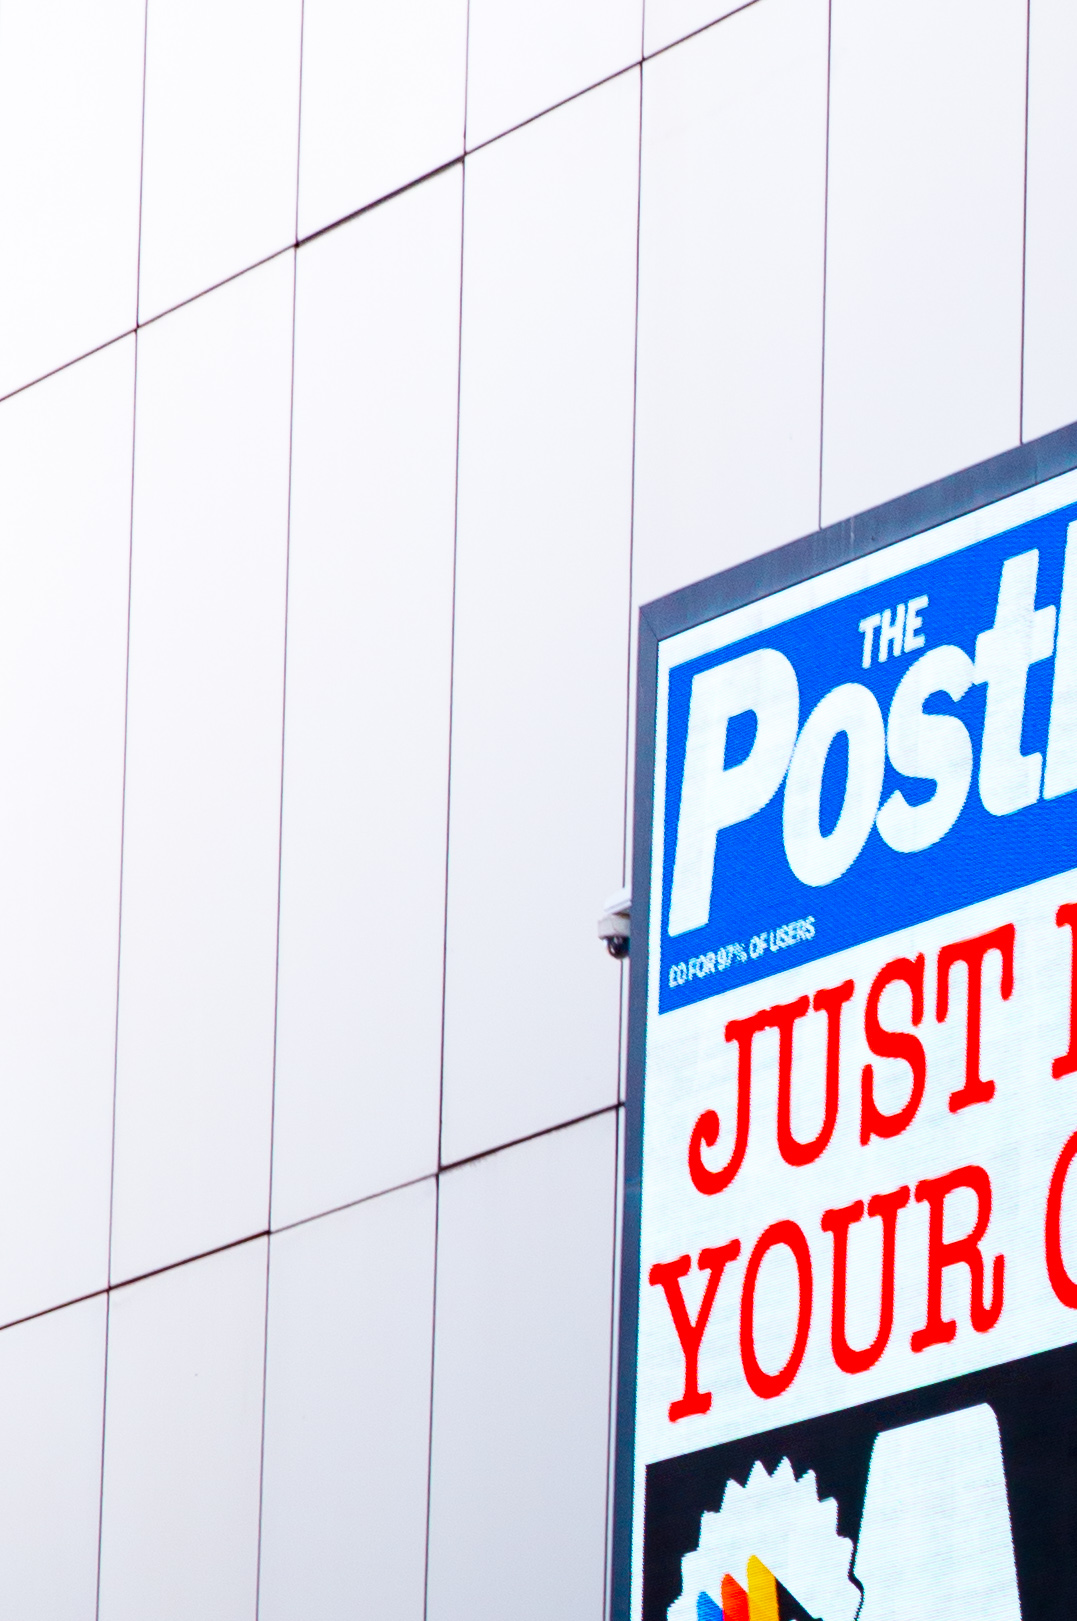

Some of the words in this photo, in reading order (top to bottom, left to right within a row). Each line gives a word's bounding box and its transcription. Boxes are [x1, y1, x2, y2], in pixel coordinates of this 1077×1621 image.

[858, 595, 930, 669] THE
[688, 951, 717, 981] FOR
[749, 931, 769, 960] OF
[769, 915, 816, 953] USERS
[687, 922, 1015, 1197] JUST
[648, 1164, 1006, 1423] YOUR
